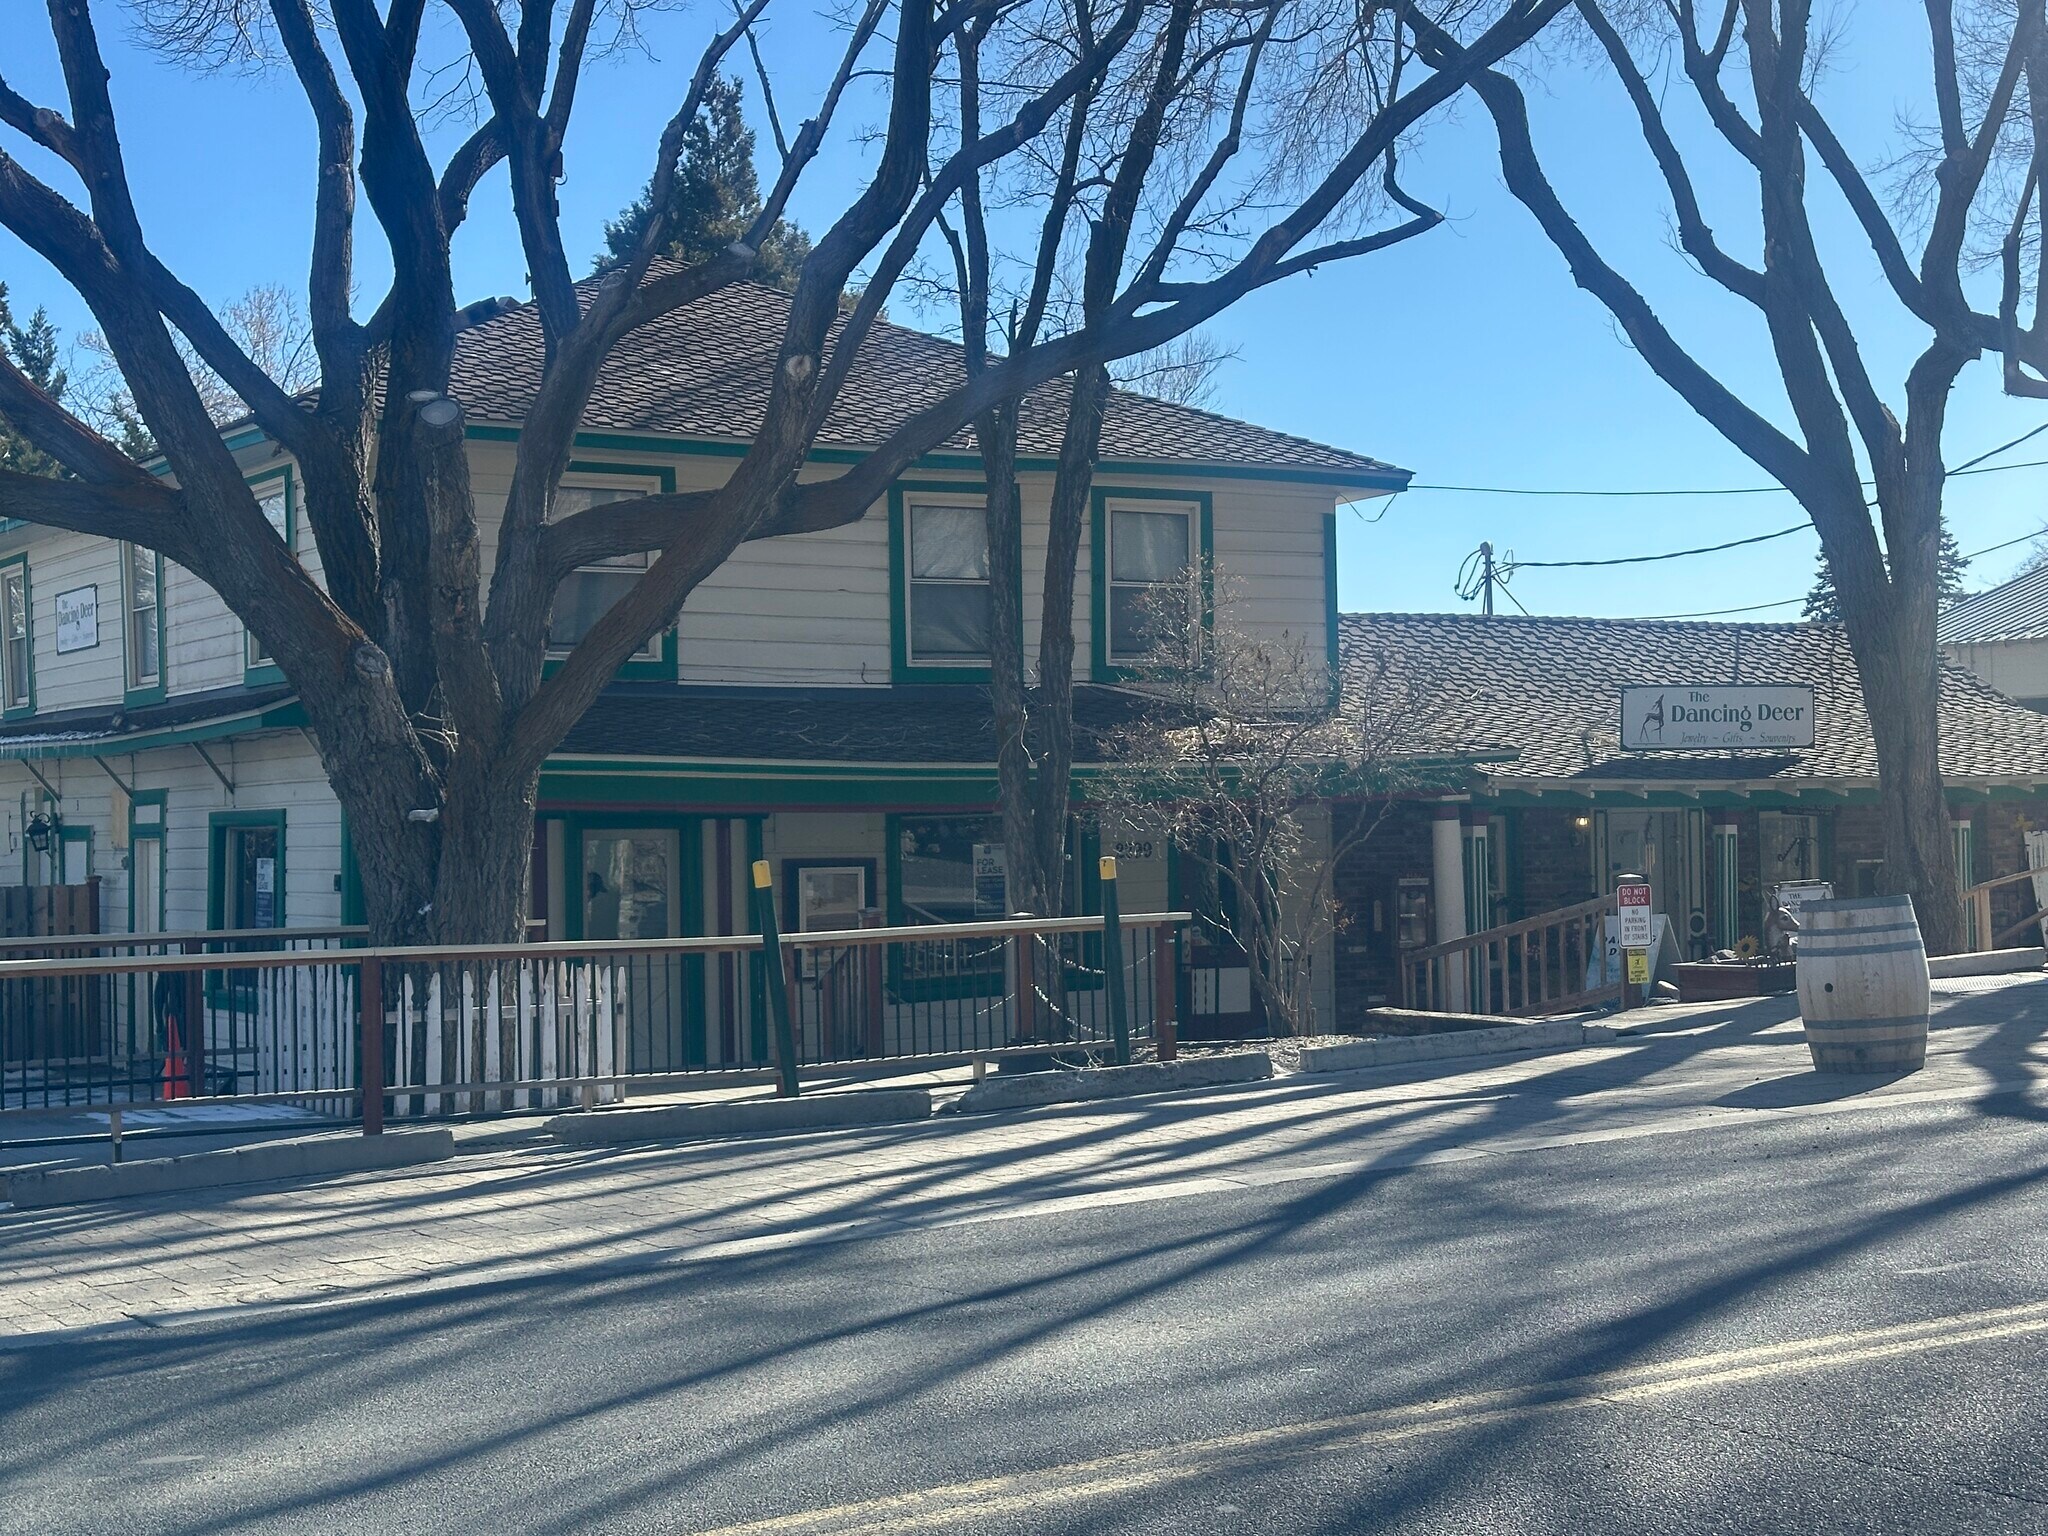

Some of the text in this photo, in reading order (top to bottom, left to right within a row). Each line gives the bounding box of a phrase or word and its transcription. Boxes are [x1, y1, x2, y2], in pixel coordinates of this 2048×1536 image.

[58, 602, 94, 630] Dancing Deer
[1688, 691, 1710, 702] The
[1671, 704, 1804, 732] Dancing Deer
[1680, 732, 1796, 744] Jewelry Gifts Souvenirs
[976, 858, 995, 866] FOR
[977, 866, 1004, 874] LEASE
[1623, 896, 1646, 905] BLOCK
